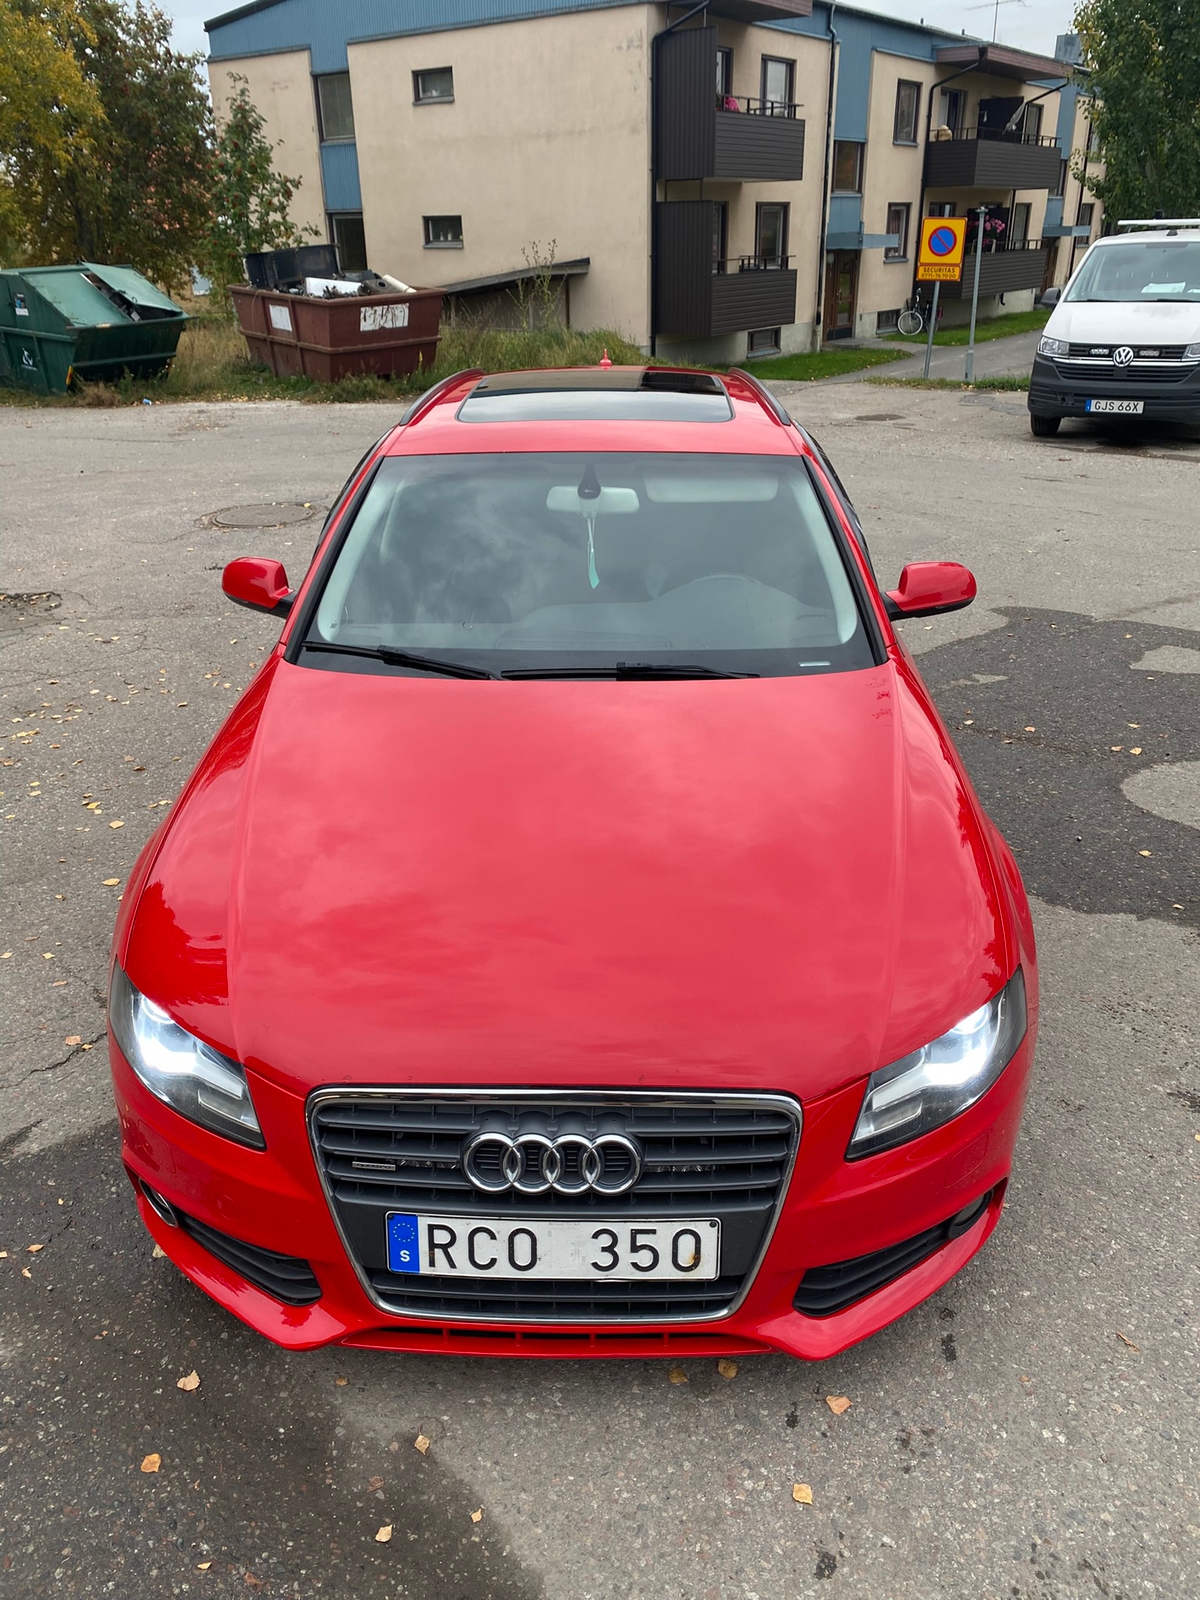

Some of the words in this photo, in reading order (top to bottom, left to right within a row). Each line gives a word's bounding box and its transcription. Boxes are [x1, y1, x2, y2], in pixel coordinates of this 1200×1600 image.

[1094, 401, 1115, 411] GJS
[1117, 402, 1139, 412] 66X
[426, 1223, 538, 1272] RCO
[590, 1228, 702, 1273] 350
[399, 1249, 411, 1263] S
